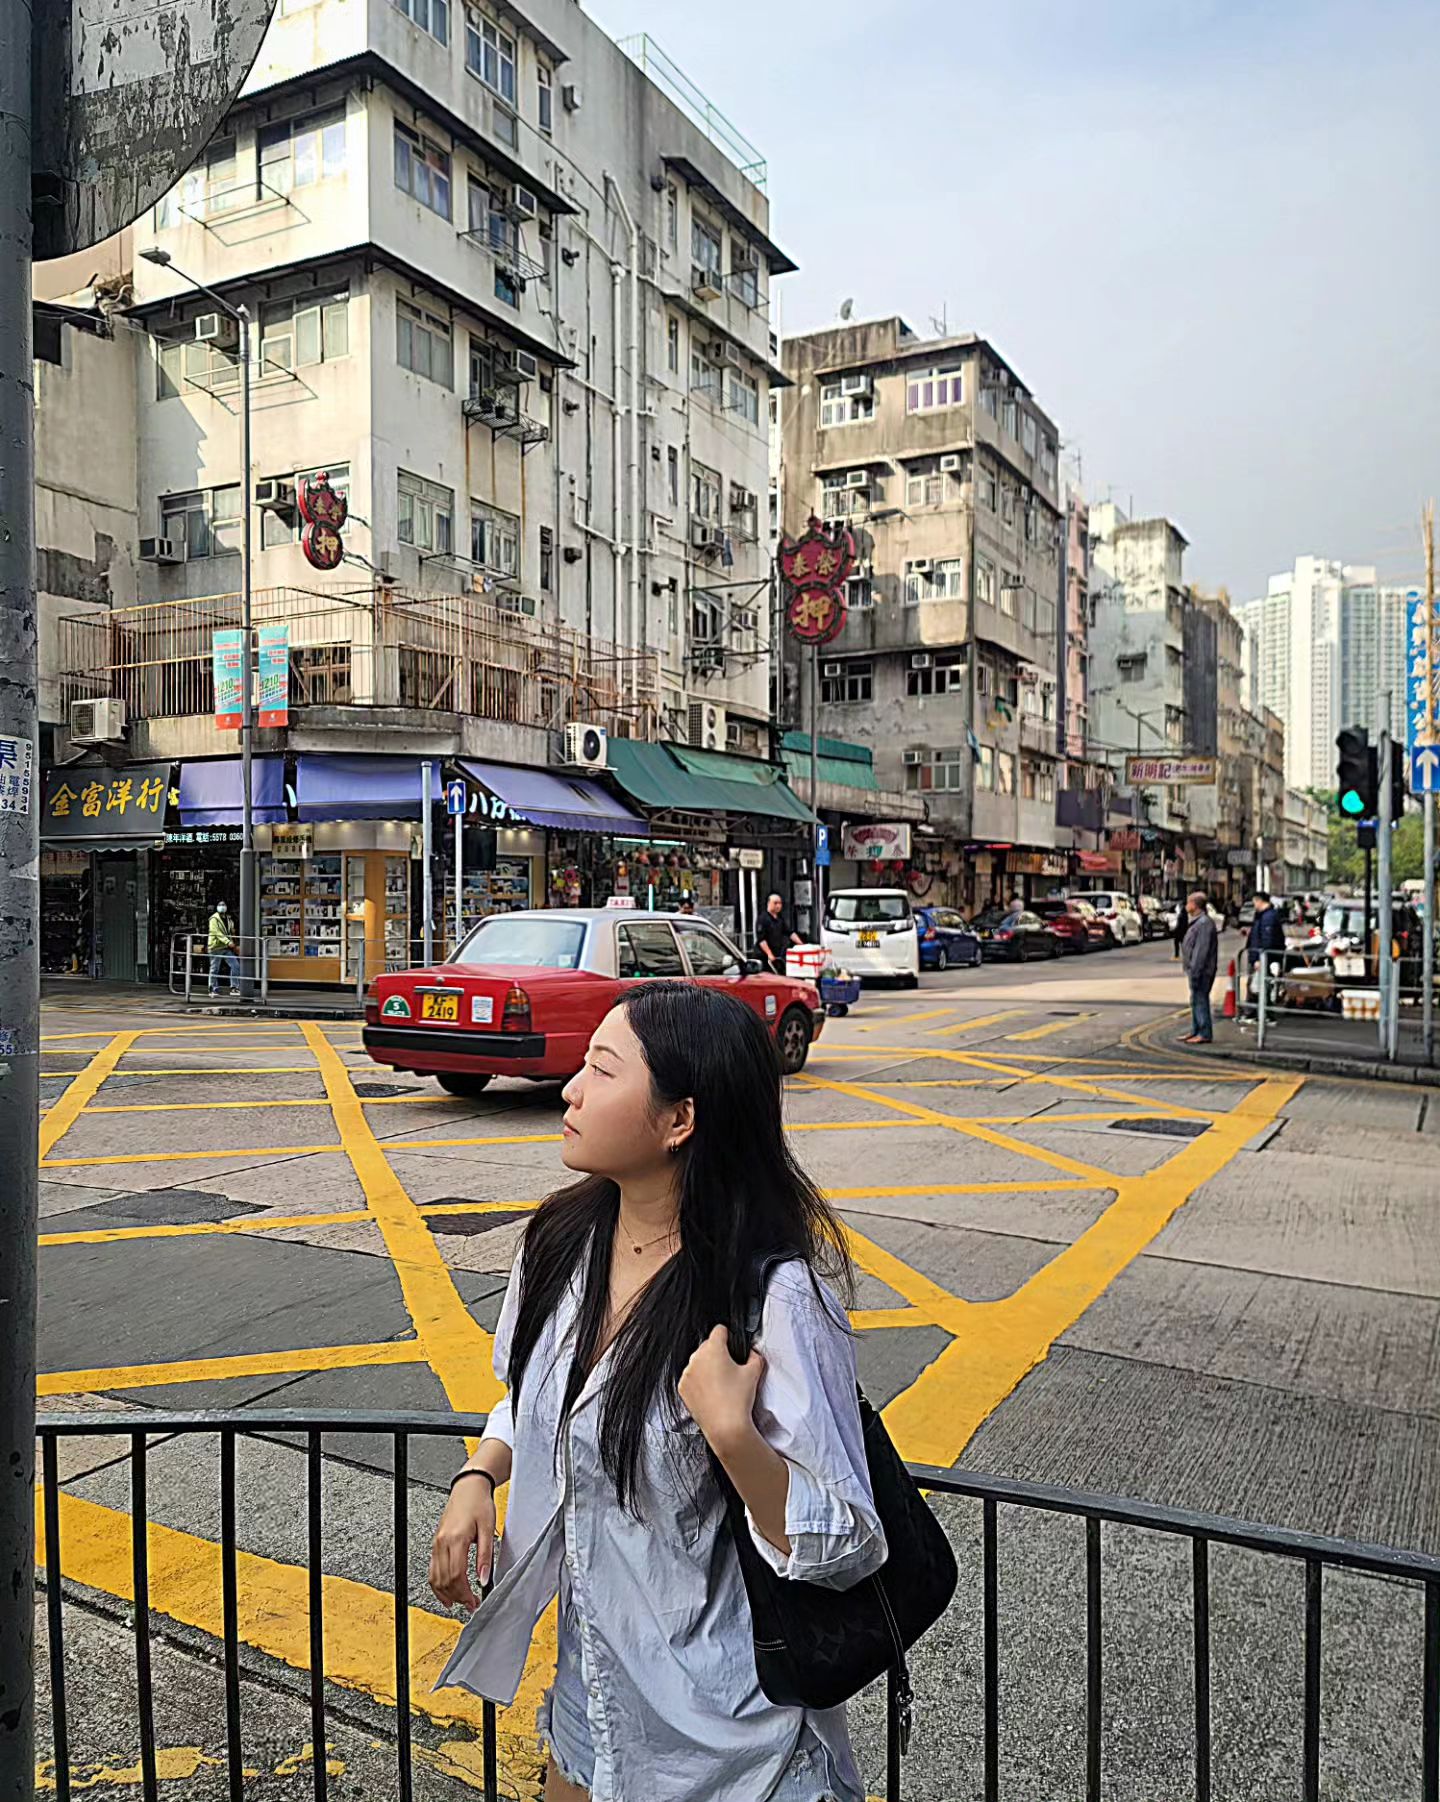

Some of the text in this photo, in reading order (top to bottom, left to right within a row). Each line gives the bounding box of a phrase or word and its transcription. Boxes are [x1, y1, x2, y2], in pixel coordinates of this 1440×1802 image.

[315, 527, 339, 562] 押
[792, 592, 831, 630] 押
[49, 777, 164, 817] 金富洋行
[818, 829, 826, 847] P
[427, 1006, 454, 1018] 2419
[433, 994, 447, 1006] KF
